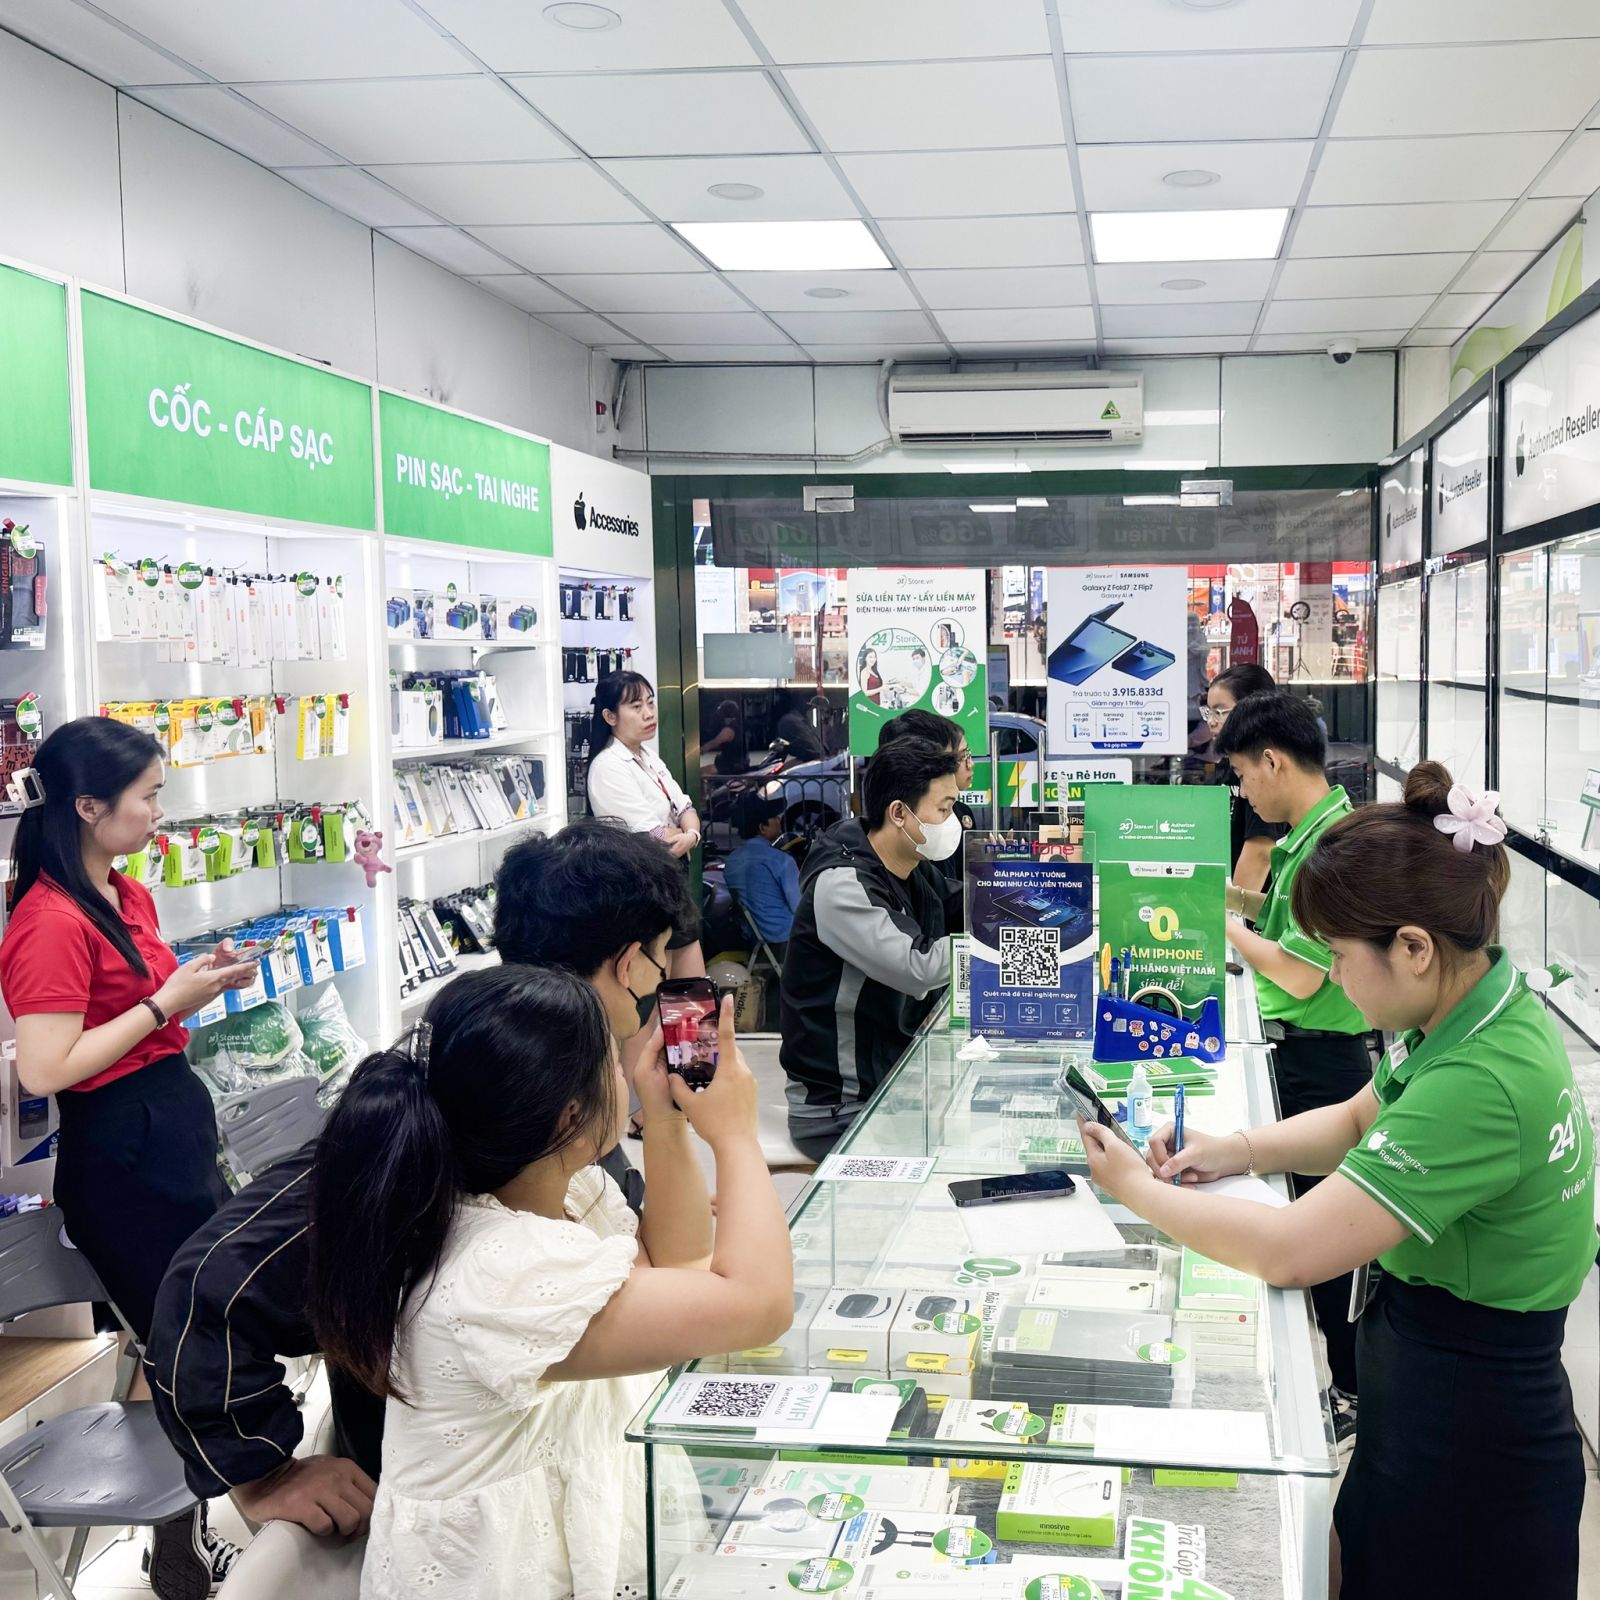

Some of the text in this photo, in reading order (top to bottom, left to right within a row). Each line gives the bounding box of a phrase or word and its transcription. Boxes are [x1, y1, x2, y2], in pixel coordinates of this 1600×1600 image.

[149, 383, 334, 470] CỐC - CÁP SẠC
[1527, 419, 1564, 460] Authorized
[396, 453, 427, 488] PIN
[429, 461, 464, 499] SẠC
[475, 472, 498, 503] TAI
[501, 479, 541, 512] NGHE
[589, 506, 640, 537] Accessories
[1082, 584, 1107, 592] Galaxy
[856, 592, 873, 602] SỬA
[895, 594, 911, 602] TAY
[956, 592, 976, 601] MÁY
[1112, 687, 1163, 697] 3.915.833đ
[1140, 723, 1150, 738] 3
[1093, 769, 1116, 780] Hơn
[977, 880, 992, 888] CHO
[1039, 909, 1063, 922] eSIM
[1153, 948, 1204, 960] IPHONE
[1170, 964, 1192, 976] VIỆT
[1193, 967, 1217, 975] NAM
[1548, 1114, 1576, 1164] 24
[1378, 1150, 1409, 1175] Reseller
[1387, 1141, 1430, 1175] Authorized
[787, 1396, 813, 1422] WIFI
[1039, 1522, 1070, 1532] innostyle
[1173, 1523, 1200, 1577] Trả Góp
